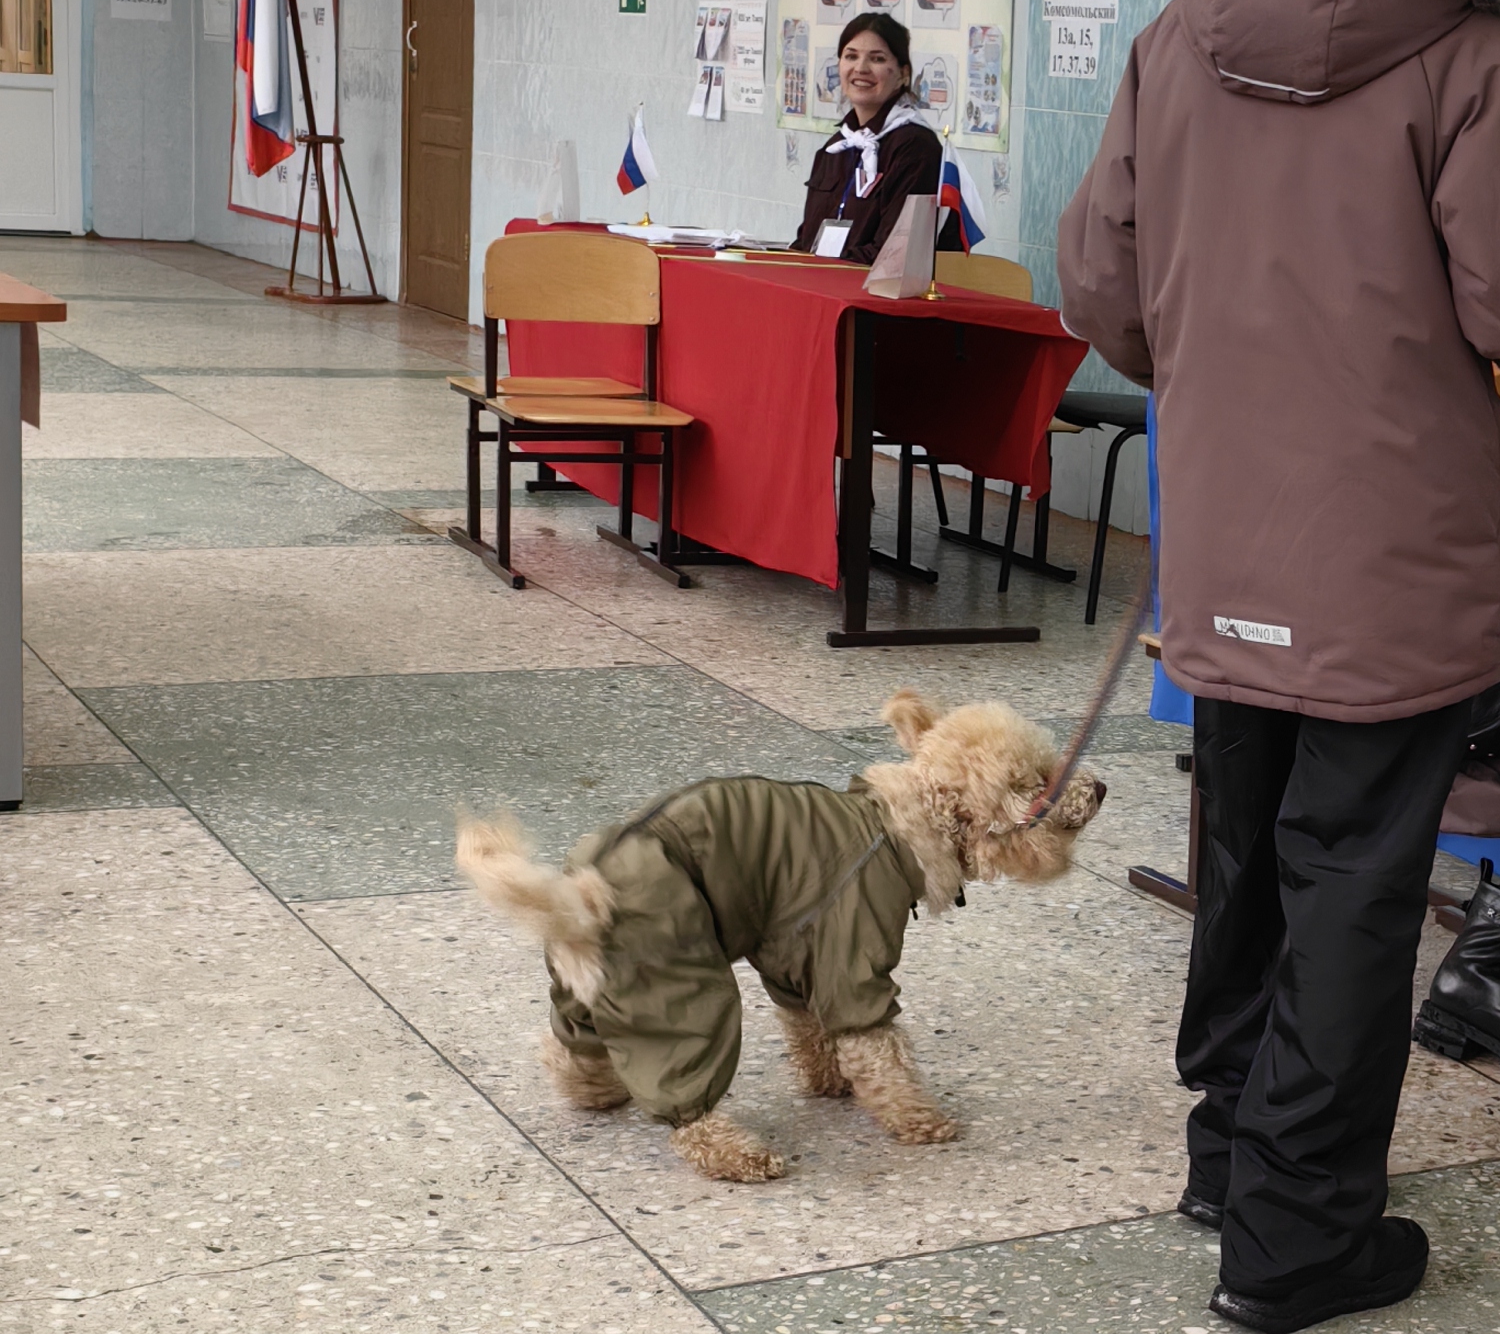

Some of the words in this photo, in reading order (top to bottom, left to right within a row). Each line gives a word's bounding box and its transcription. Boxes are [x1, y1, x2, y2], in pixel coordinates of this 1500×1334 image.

[1043, 1, 1116, 20] Комсомольский
[1079, 28, 1093, 49] 15,
[1084, 56, 1096, 75] 39
